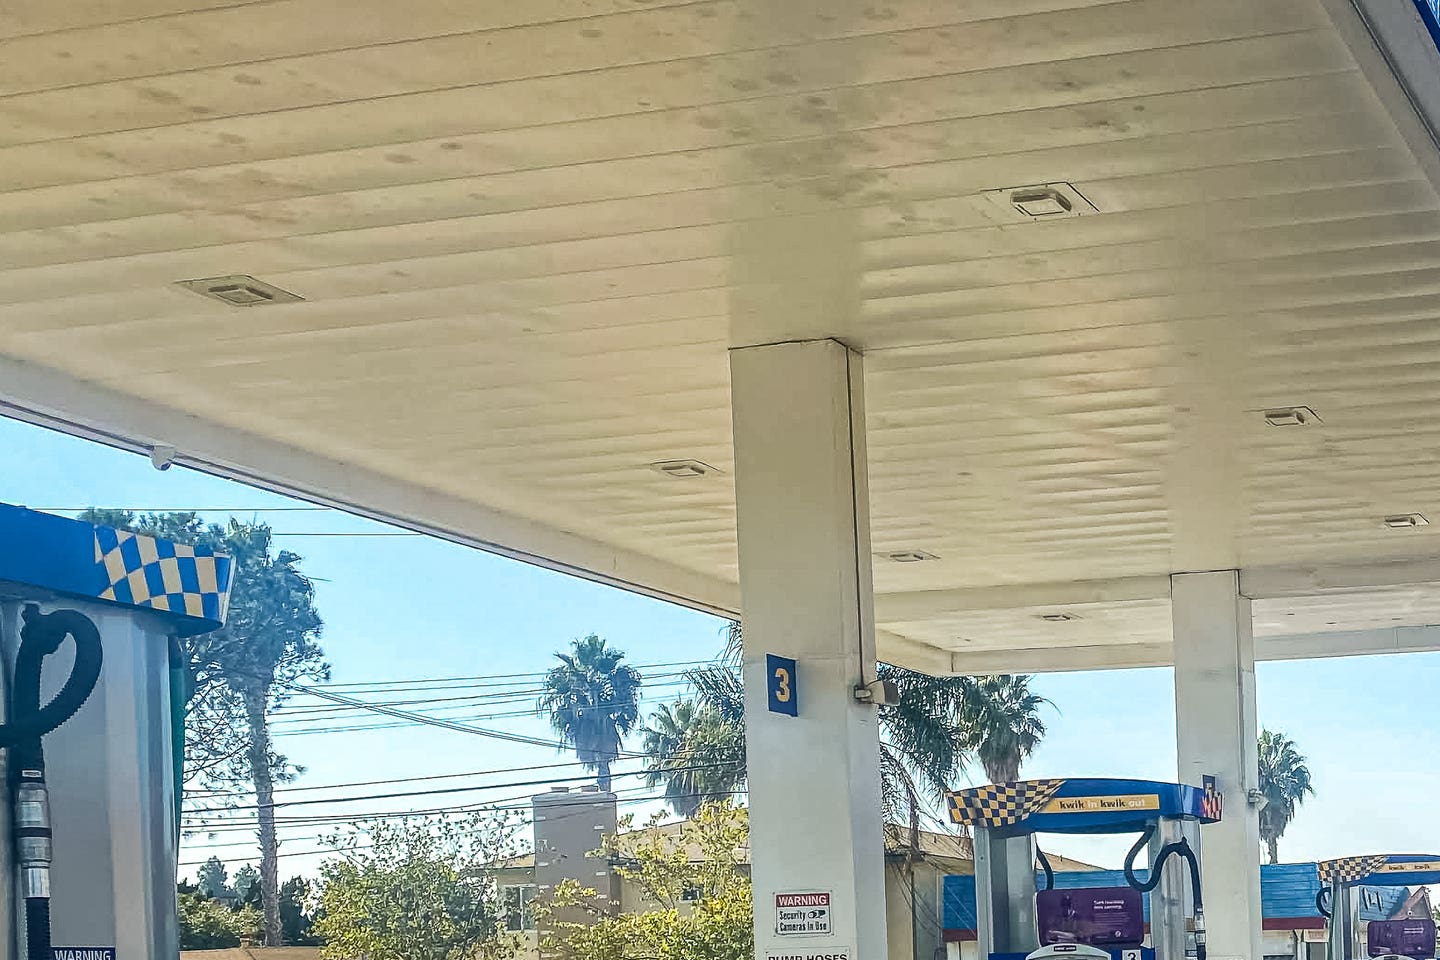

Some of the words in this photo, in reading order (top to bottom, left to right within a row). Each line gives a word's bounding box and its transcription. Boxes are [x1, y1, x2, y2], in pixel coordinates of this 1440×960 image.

[774, 668, 790, 702] 3
[1060, 800, 1084, 809] kwik
[1100, 799, 1126, 808] kwik
[778, 895, 827, 906] WARNING
[779, 910, 806, 921] Security
[780, 921, 806, 932] Cameras
[807, 921, 814, 931] In
[815, 920, 827, 931] Use
